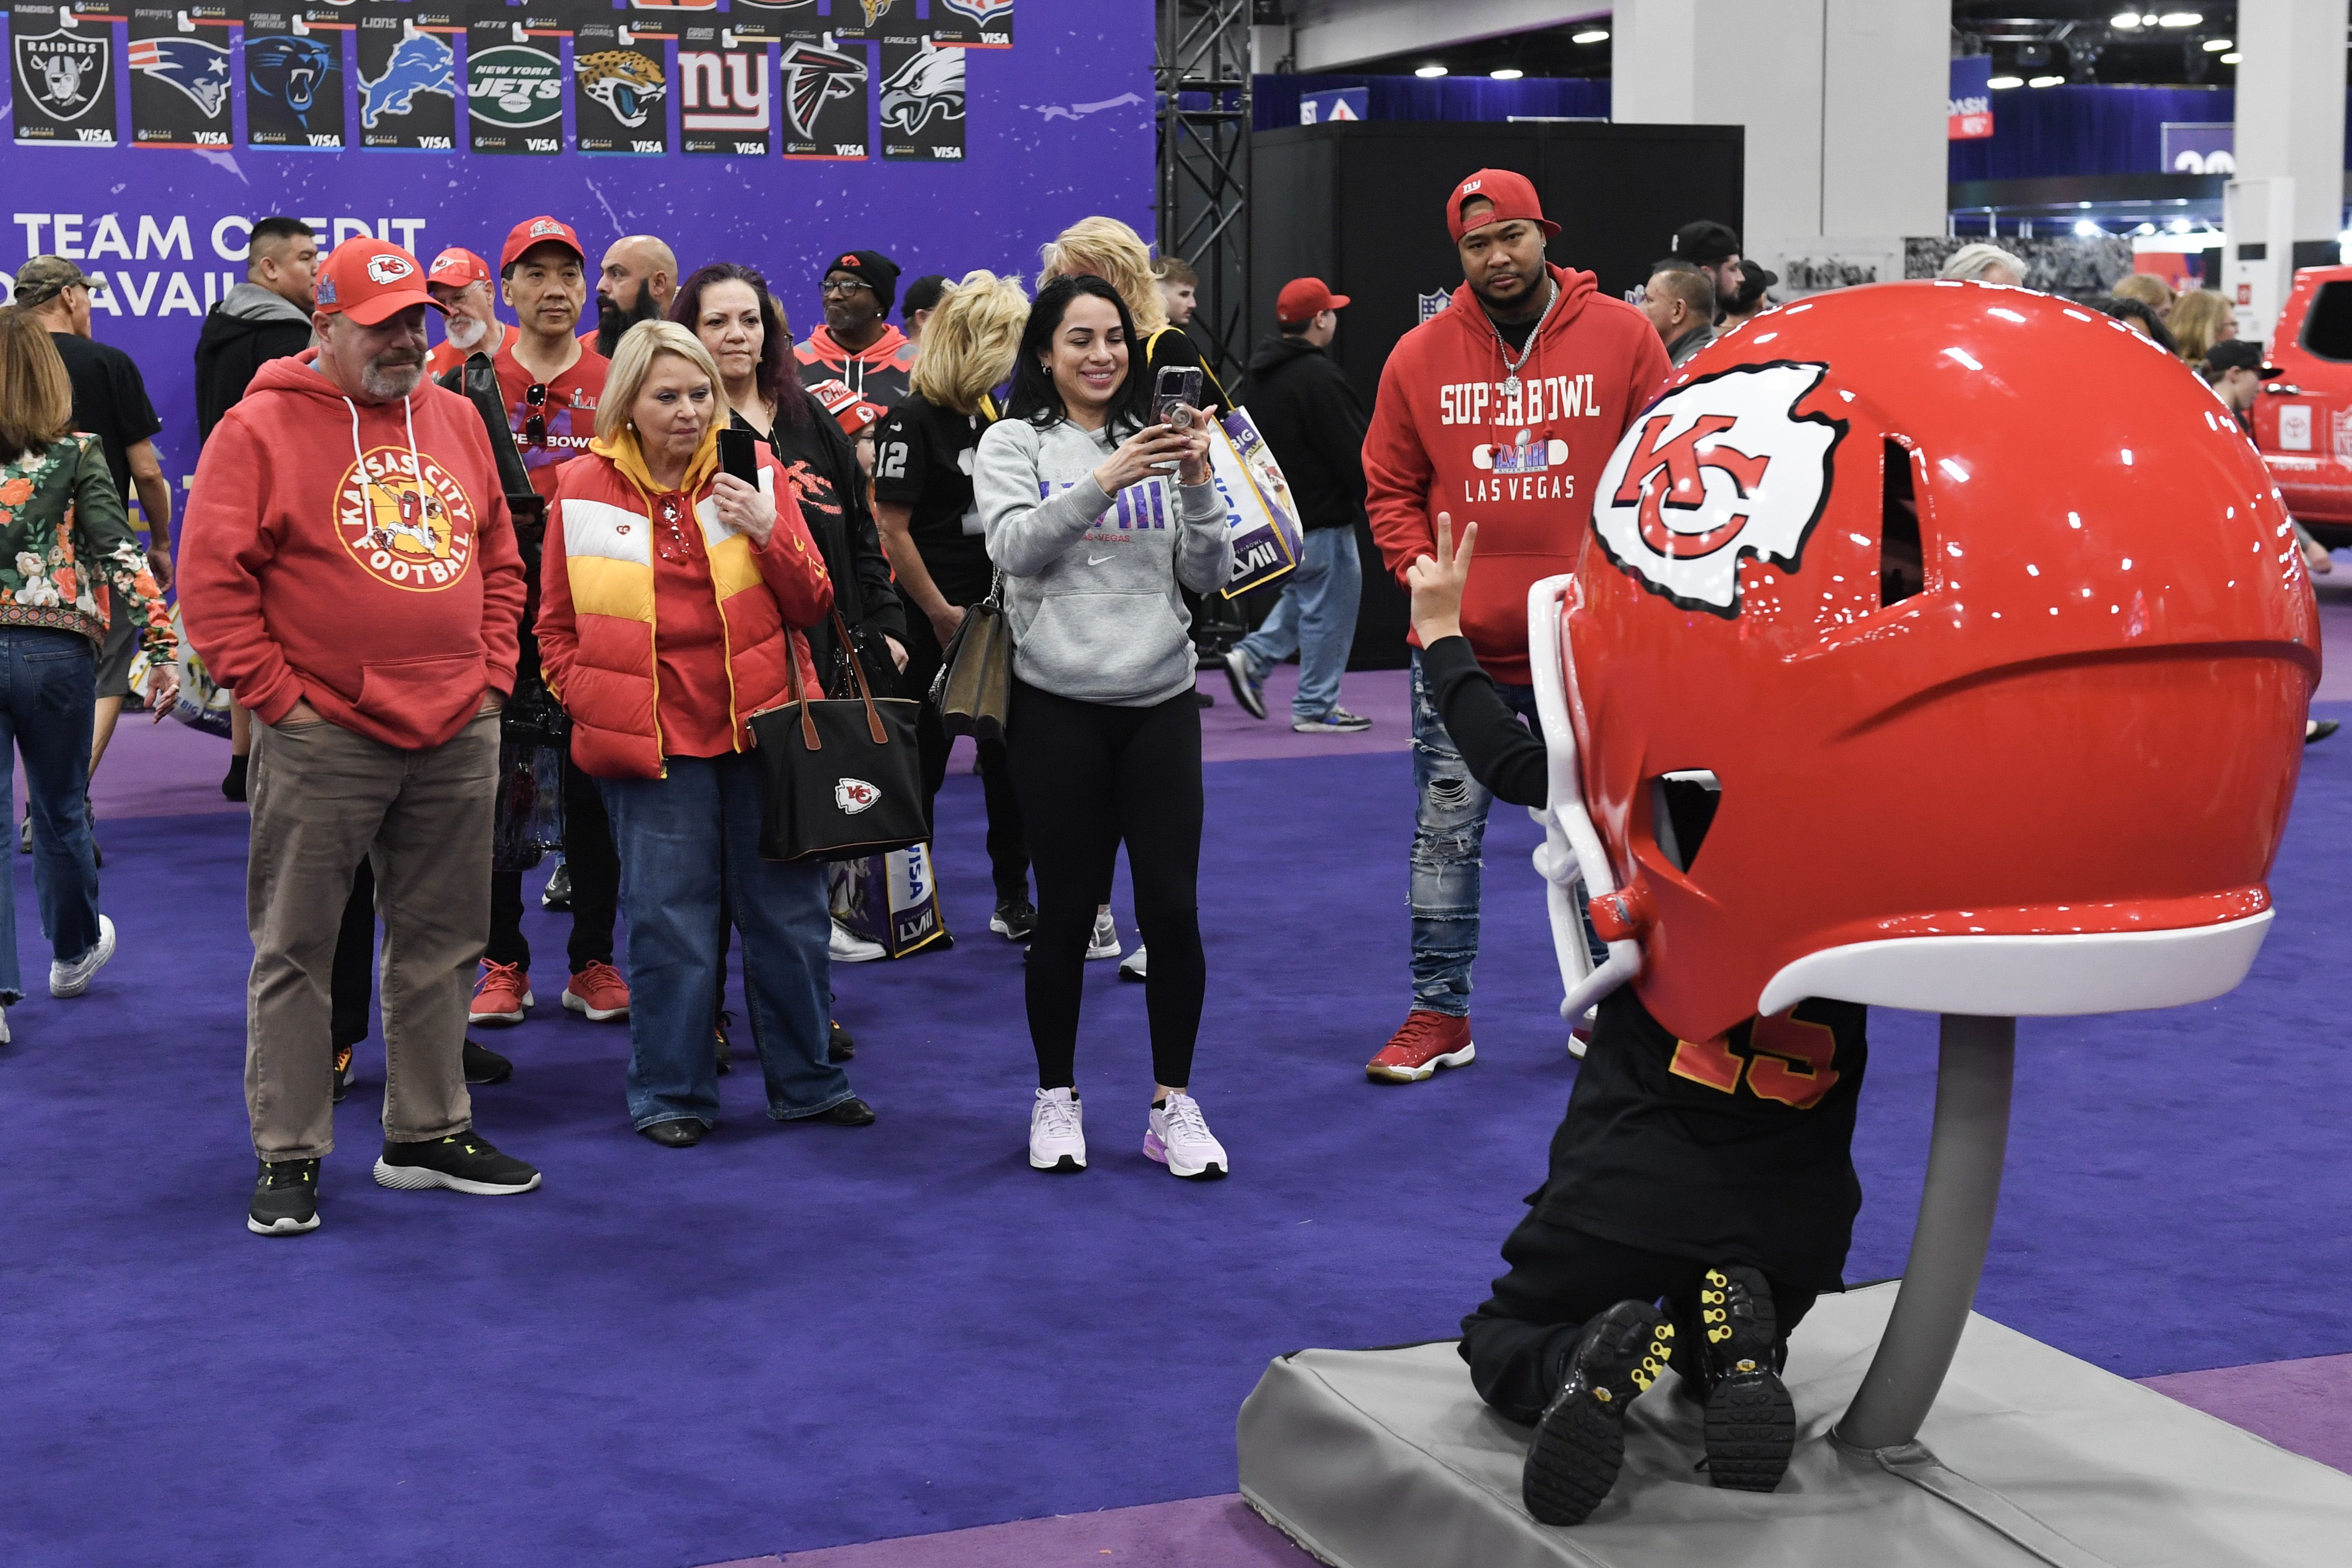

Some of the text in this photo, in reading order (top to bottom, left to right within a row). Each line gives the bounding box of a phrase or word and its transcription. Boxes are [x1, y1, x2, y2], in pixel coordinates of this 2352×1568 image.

[362, 17, 398, 29] LIONS
[979, 32, 1010, 44] VISA
[27, 42, 97, 54] RAIDERS
[475, 65, 554, 76] NEW YORK
[468, 78, 562, 97] JETS
[75, 128, 113, 142] VISA
[192, 131, 228, 145] VISA
[306, 134, 341, 147] VISA
[417, 136, 451, 149] VISA
[524, 138, 558, 151] VISA
[630, 140, 663, 152] VISA
[733, 142, 765, 155] VISA
[833, 144, 864, 156] VISA
[931, 146, 962, 158] VISA
[14, 213, 193, 260] TEAM
[547, 436, 592, 448] BOW
[1230, 428, 1254, 450] BIG
[876, 441, 908, 479] 12
[424, 465, 470, 522] CITY
[1465, 475, 1574, 502] LAS VEGAS
[1611, 414, 1771, 561] KC
